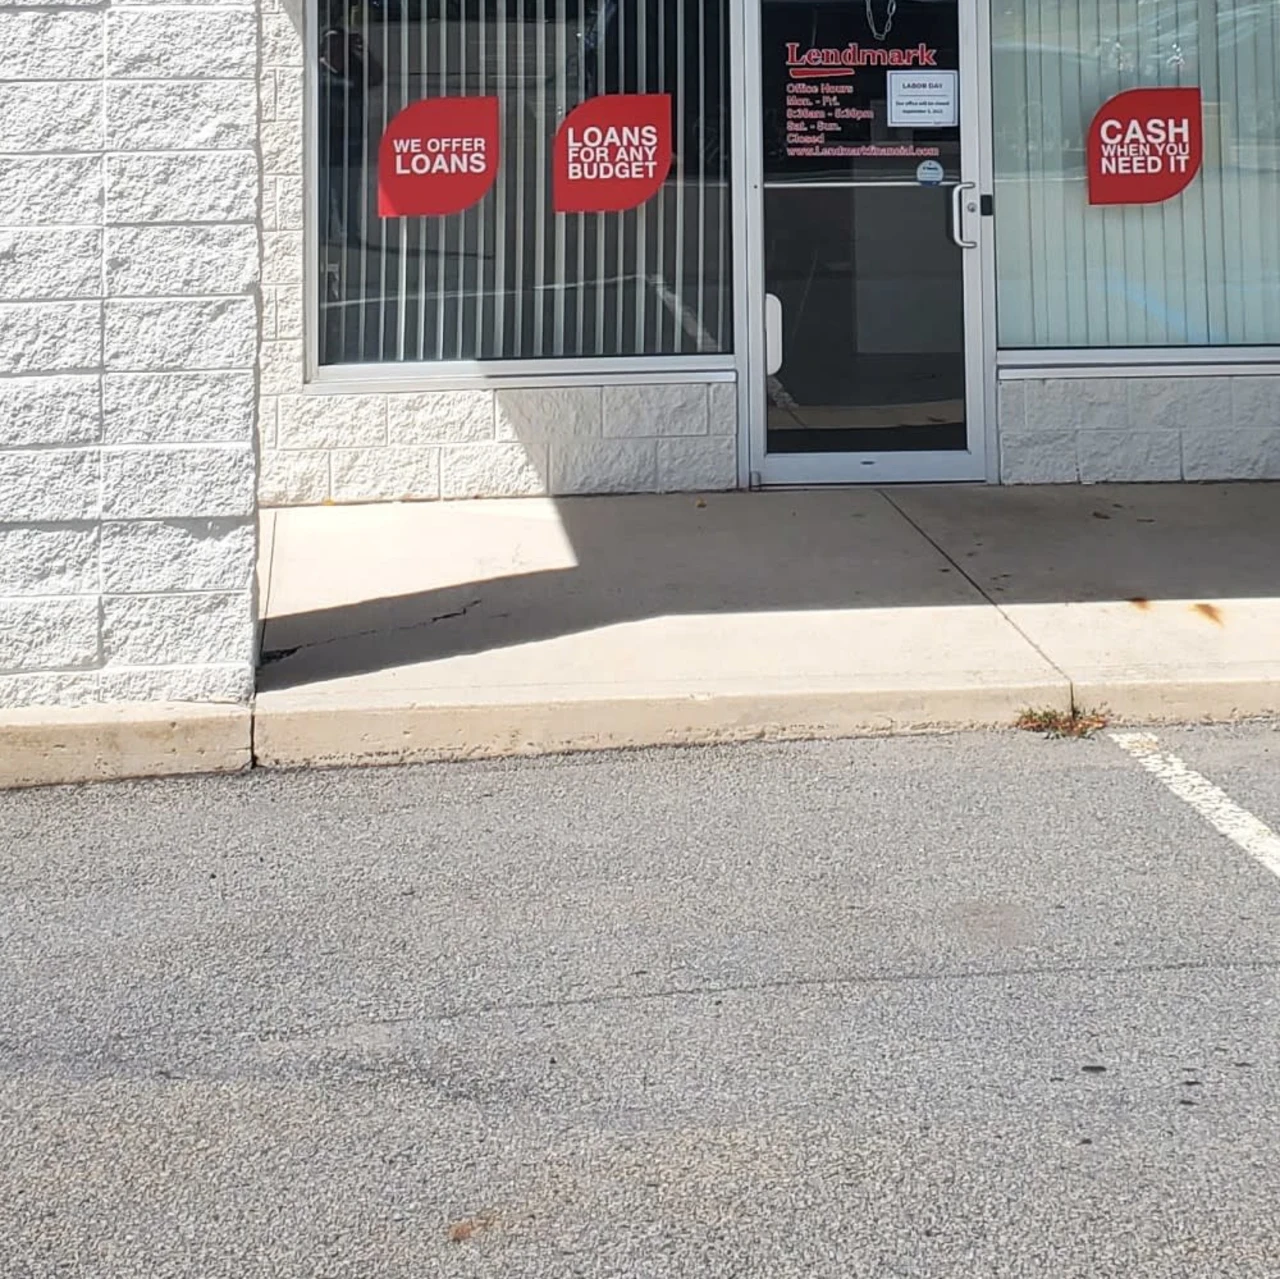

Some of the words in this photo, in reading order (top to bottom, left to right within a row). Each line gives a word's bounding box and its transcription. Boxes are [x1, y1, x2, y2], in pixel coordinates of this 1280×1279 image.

[785, 42, 937, 65] Lendmark
[786, 83, 818, 93] Office
[820, 83, 854, 93] Hours
[567, 125, 658, 147] LOANS
[786, 133, 825, 143] Closed
[1100, 118, 1189, 145] CASH
[393, 138, 422, 153] WE
[426, 137, 486, 153] OFFER
[567, 146, 609, 162] FOR
[615, 146, 657, 162] ANY
[1101, 143, 1150, 157] WHEN
[1155, 142, 1190, 156] YOU
[395, 152, 487, 174] LOANS
[567, 161, 658, 179] BUDGET
[1101, 156, 1163, 175] NEED
[1169, 155, 1190, 173] IT
